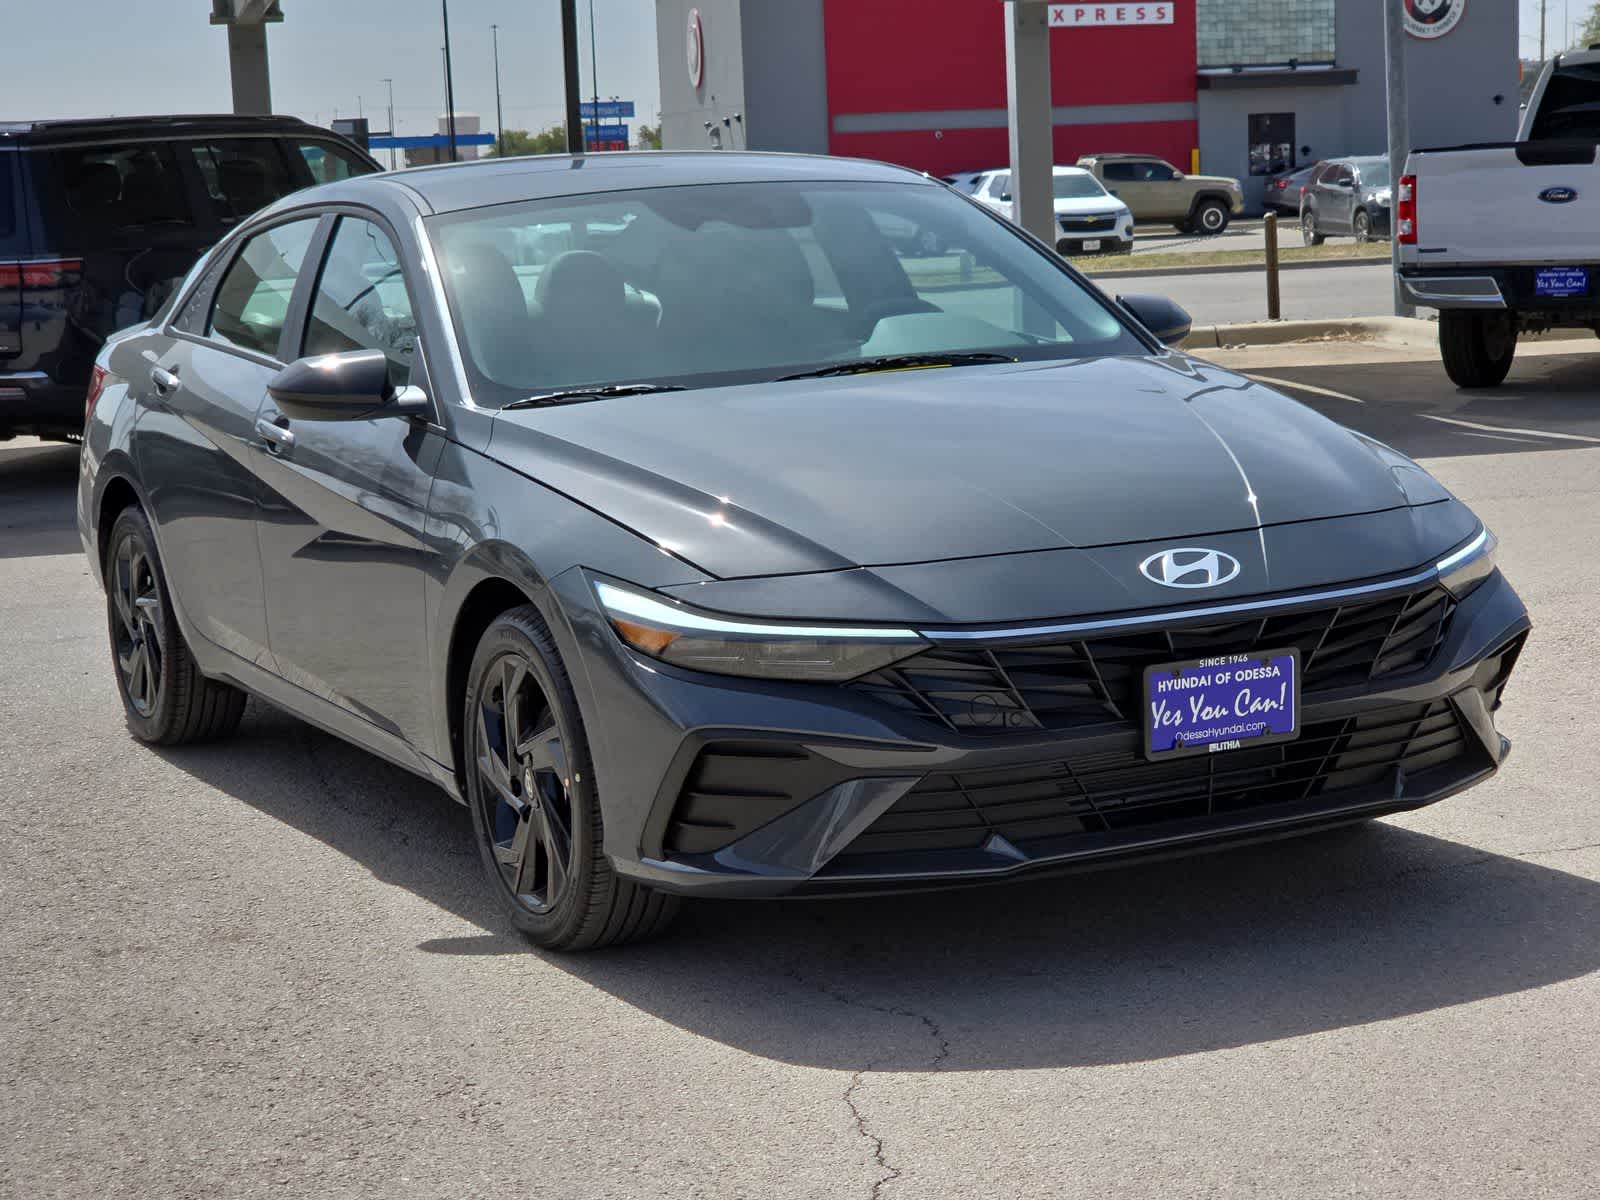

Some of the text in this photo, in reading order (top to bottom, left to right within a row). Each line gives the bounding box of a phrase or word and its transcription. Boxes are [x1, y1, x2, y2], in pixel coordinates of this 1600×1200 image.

[1053, 7, 1166, 22] XPRESS
[1199, 654, 1248, 668] SINCE 1946
[1158, 665, 1280, 693] HYUNDAI OF ODESSA
[1151, 681, 1287, 729] Yes You Can!
[1175, 721, 1267, 742] OdessaHyundai.com
[1217, 739, 1240, 751] LITHIA
